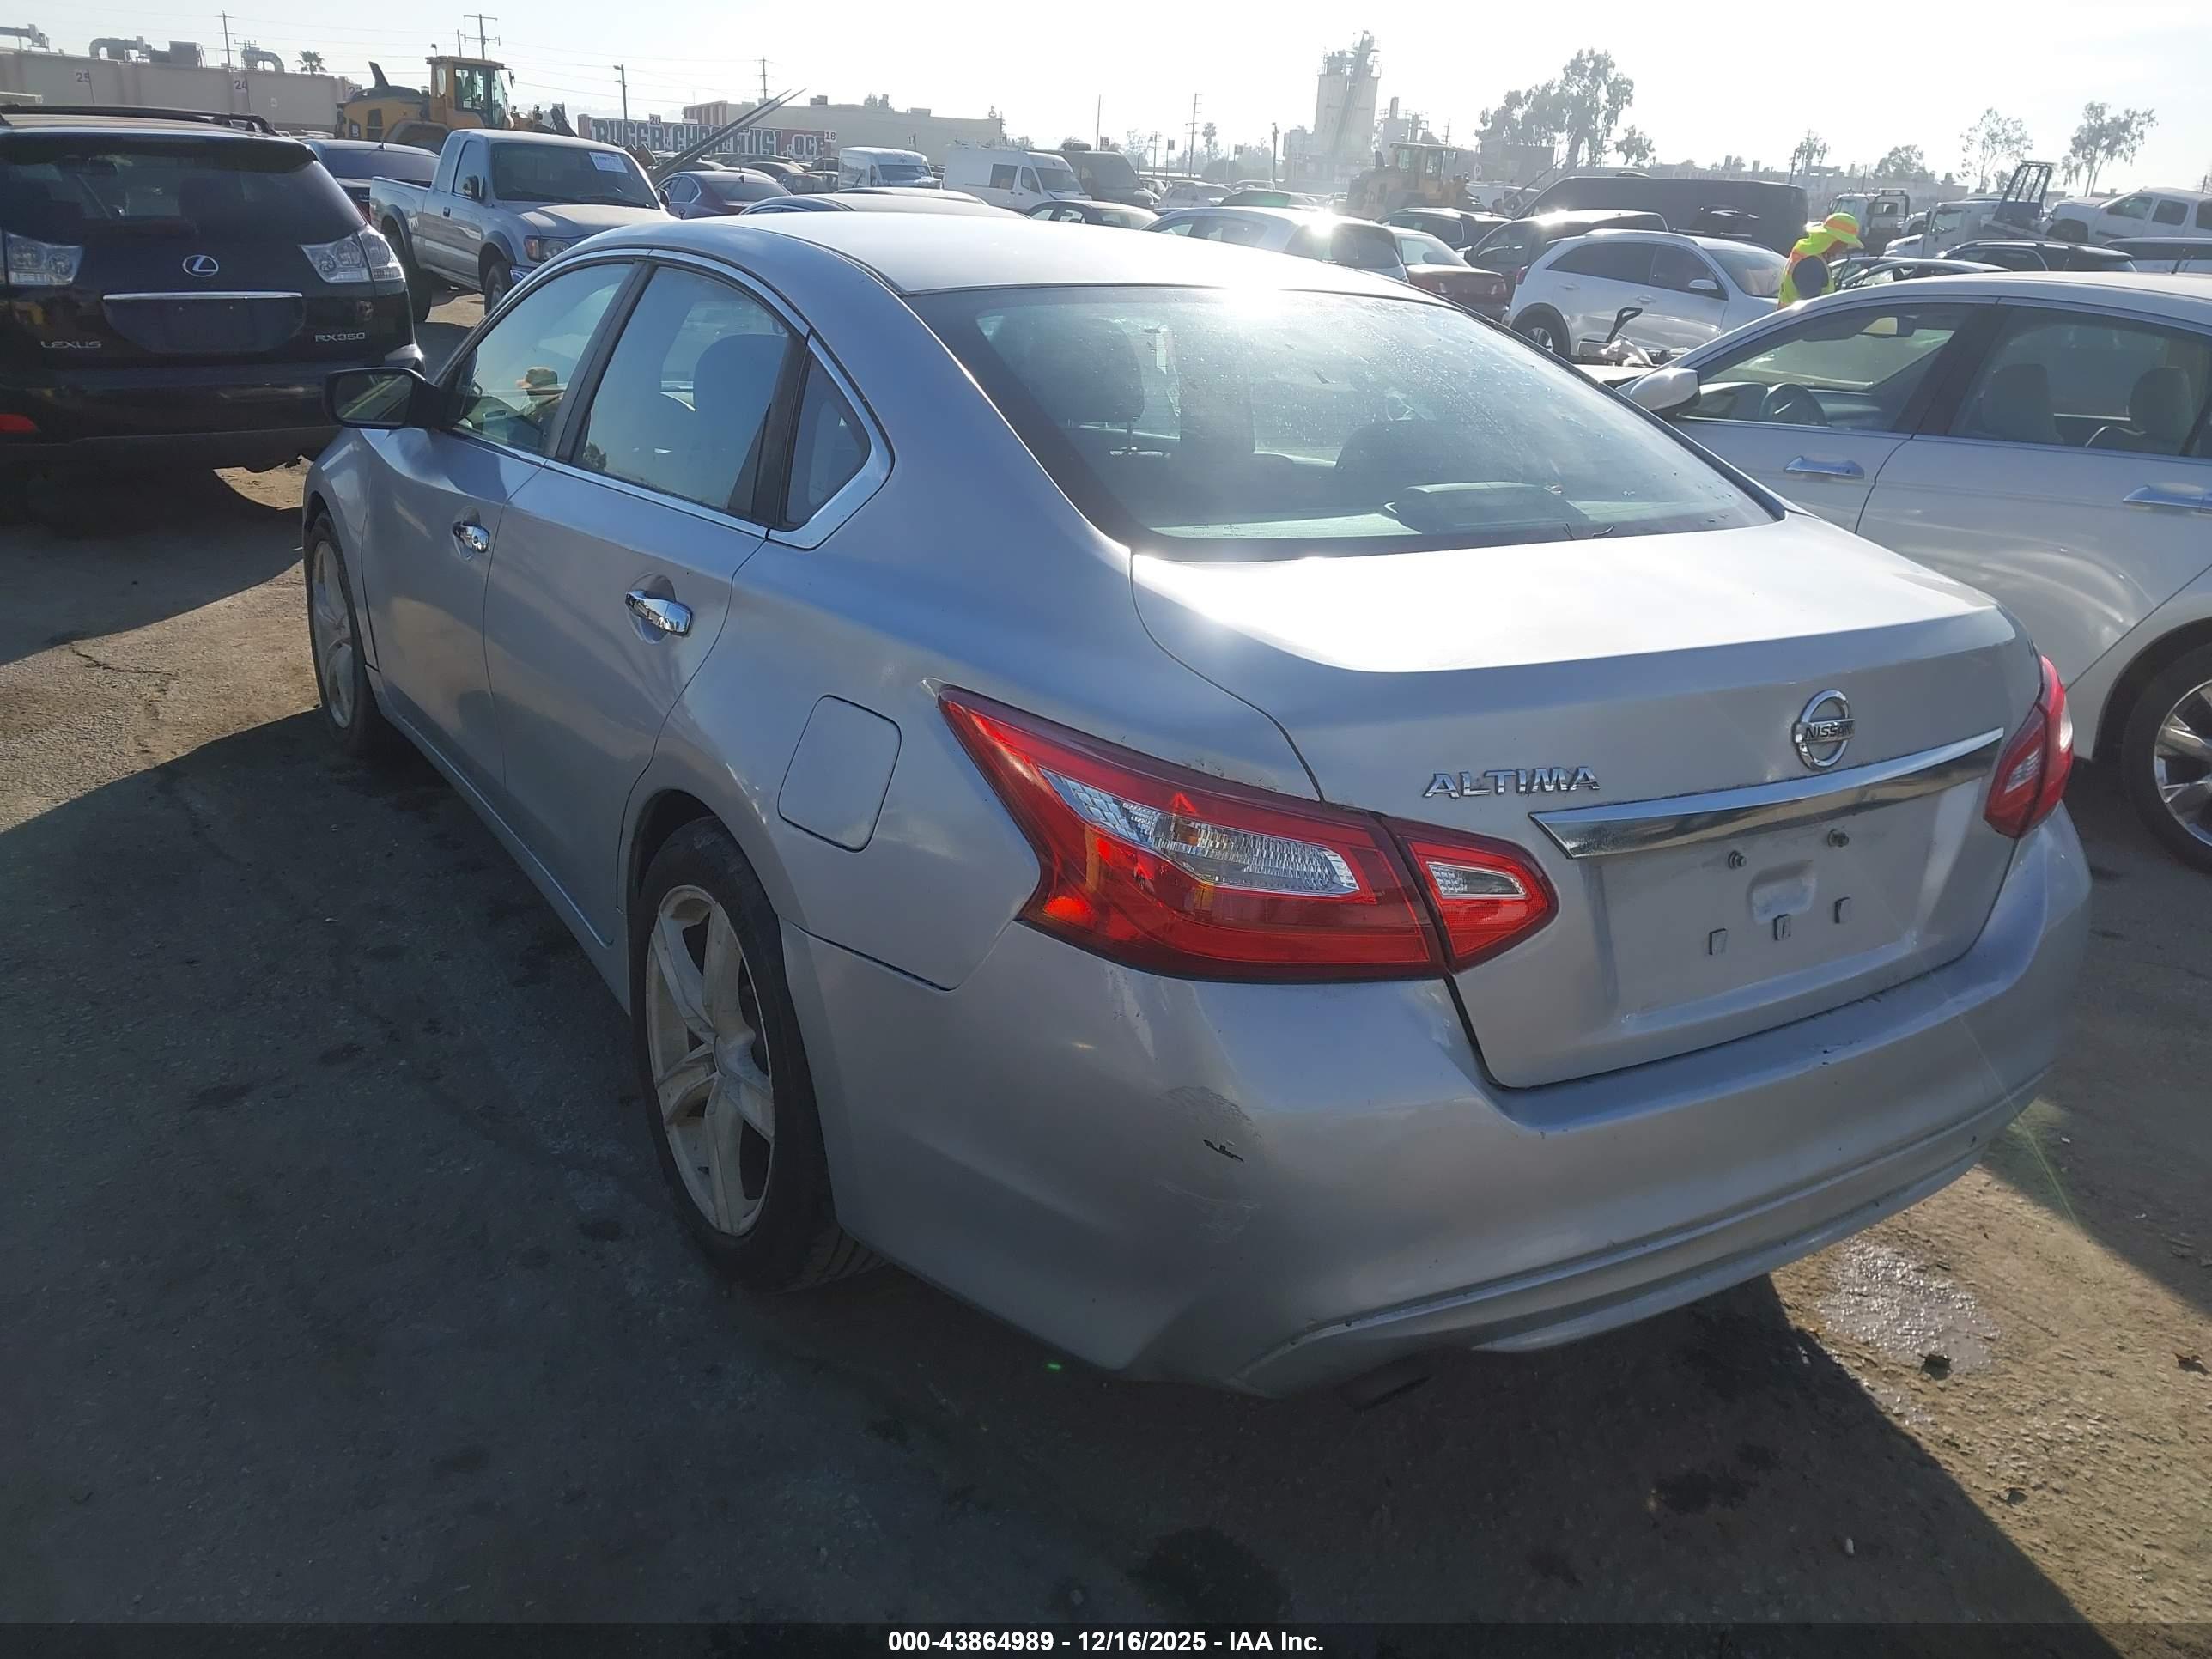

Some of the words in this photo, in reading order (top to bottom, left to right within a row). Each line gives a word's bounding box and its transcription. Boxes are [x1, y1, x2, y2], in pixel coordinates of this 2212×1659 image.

[650, 116, 660, 125] 20
[825, 131, 836, 141] 18
[40, 340, 101, 349] LEXUS
[1805, 721, 1852, 739] NISSAN
[1422, 766, 1601, 799] ALTIMA
